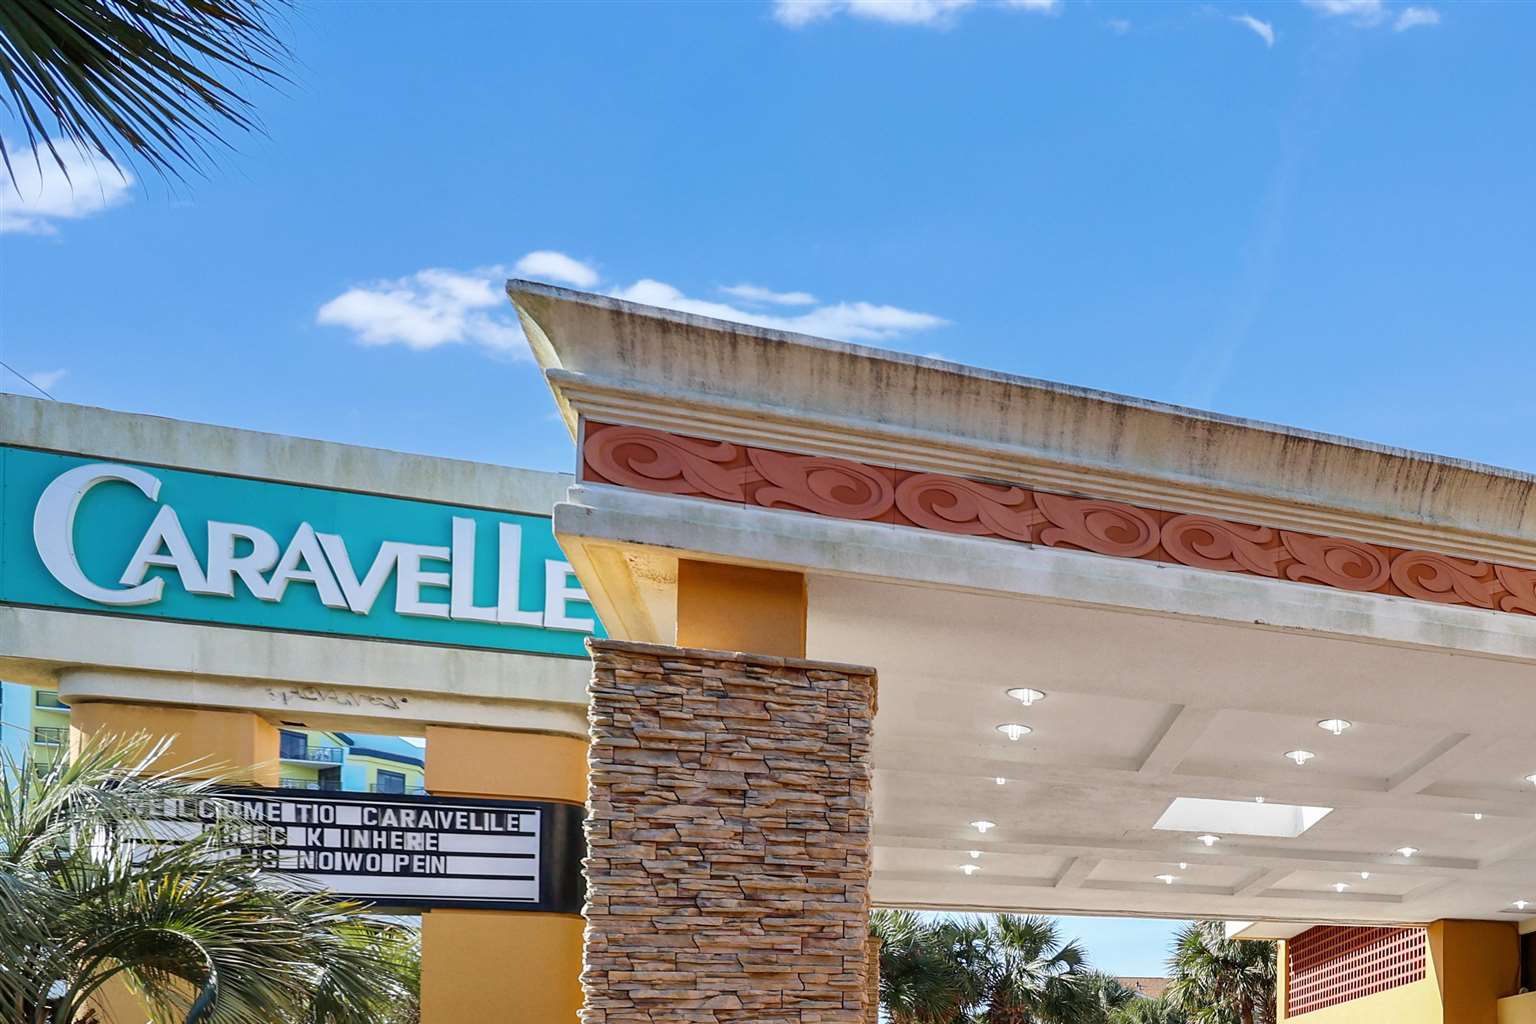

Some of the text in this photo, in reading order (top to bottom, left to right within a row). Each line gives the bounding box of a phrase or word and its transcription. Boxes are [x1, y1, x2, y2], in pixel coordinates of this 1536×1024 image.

[33, 462, 595, 634] CARAVELLE
[297, 804, 334, 823] TO
[363, 807, 520, 832] CARAVELLE
